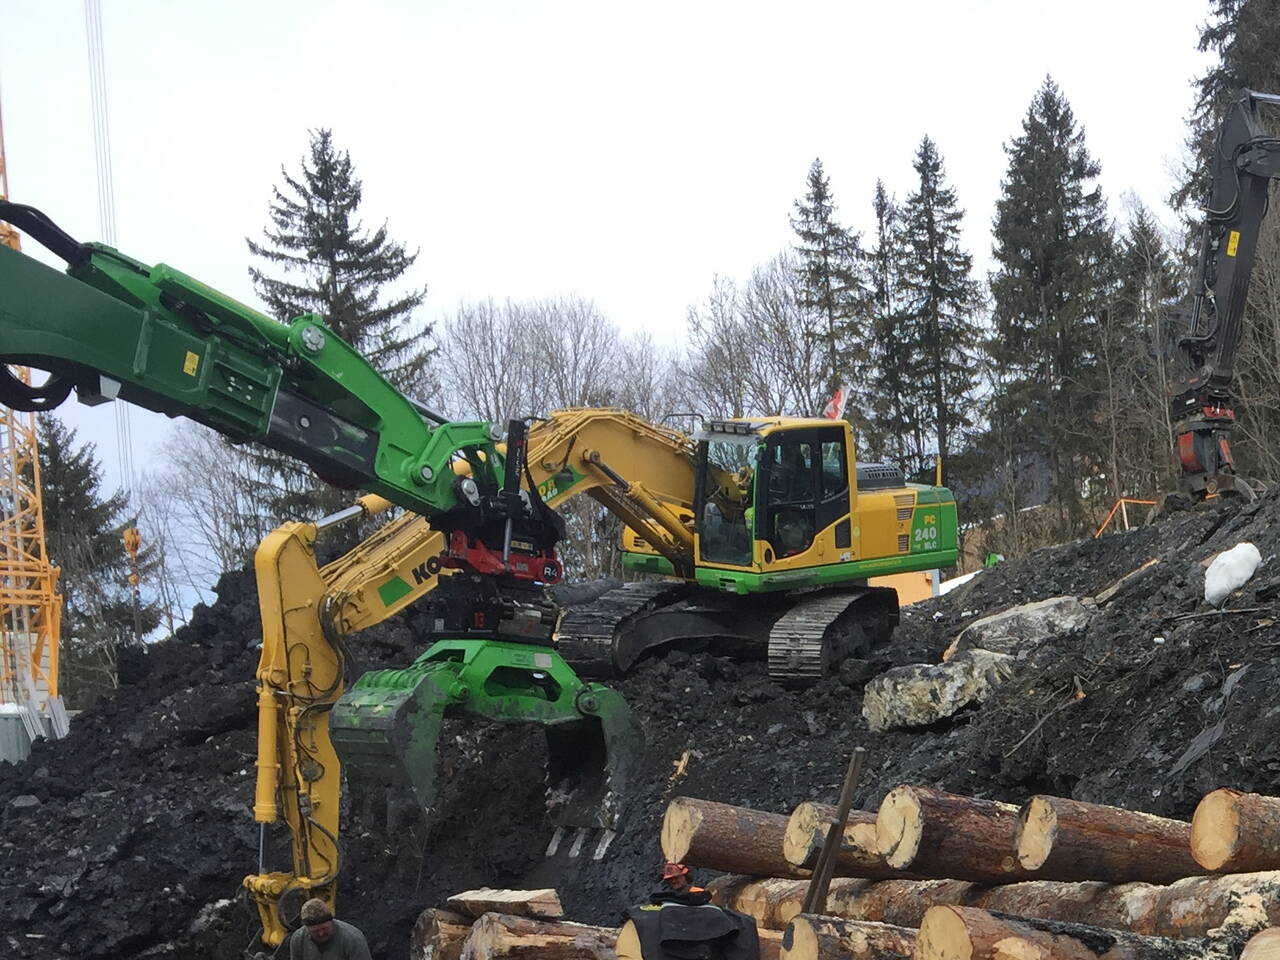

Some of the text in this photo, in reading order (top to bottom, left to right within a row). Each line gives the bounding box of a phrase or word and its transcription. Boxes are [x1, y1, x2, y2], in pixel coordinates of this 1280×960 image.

[923, 514, 937, 525] PC
[914, 526, 937, 542] 240
[411, 555, 442, 585] KO
[544, 566, 558, 577] R4
